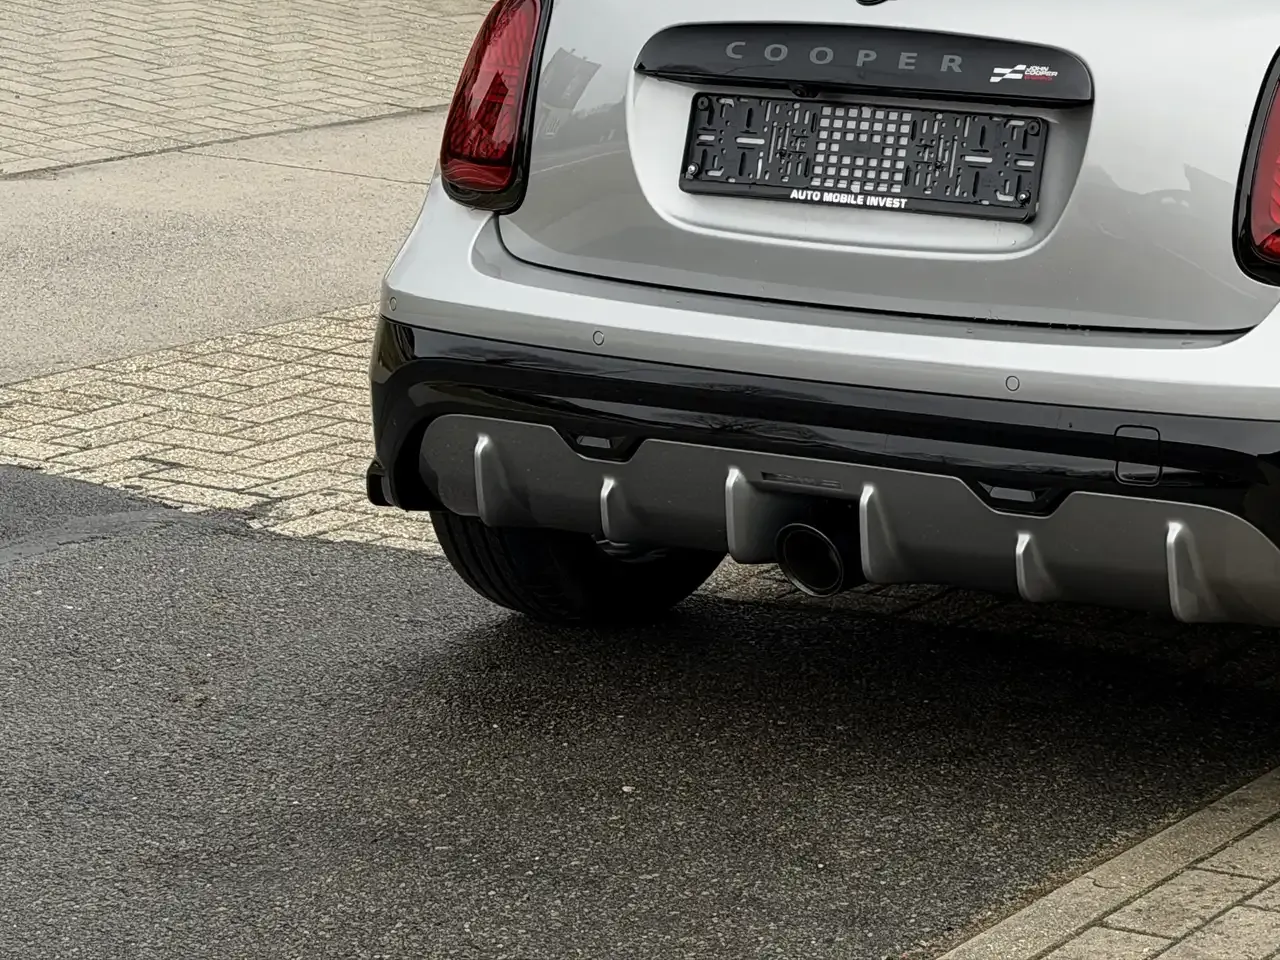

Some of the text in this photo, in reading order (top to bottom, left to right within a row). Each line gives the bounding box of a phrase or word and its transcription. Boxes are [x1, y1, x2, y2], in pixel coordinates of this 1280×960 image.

[725, 41, 963, 73] COOPER
[789, 188, 908, 209] AUTO MOBILE INVEST
